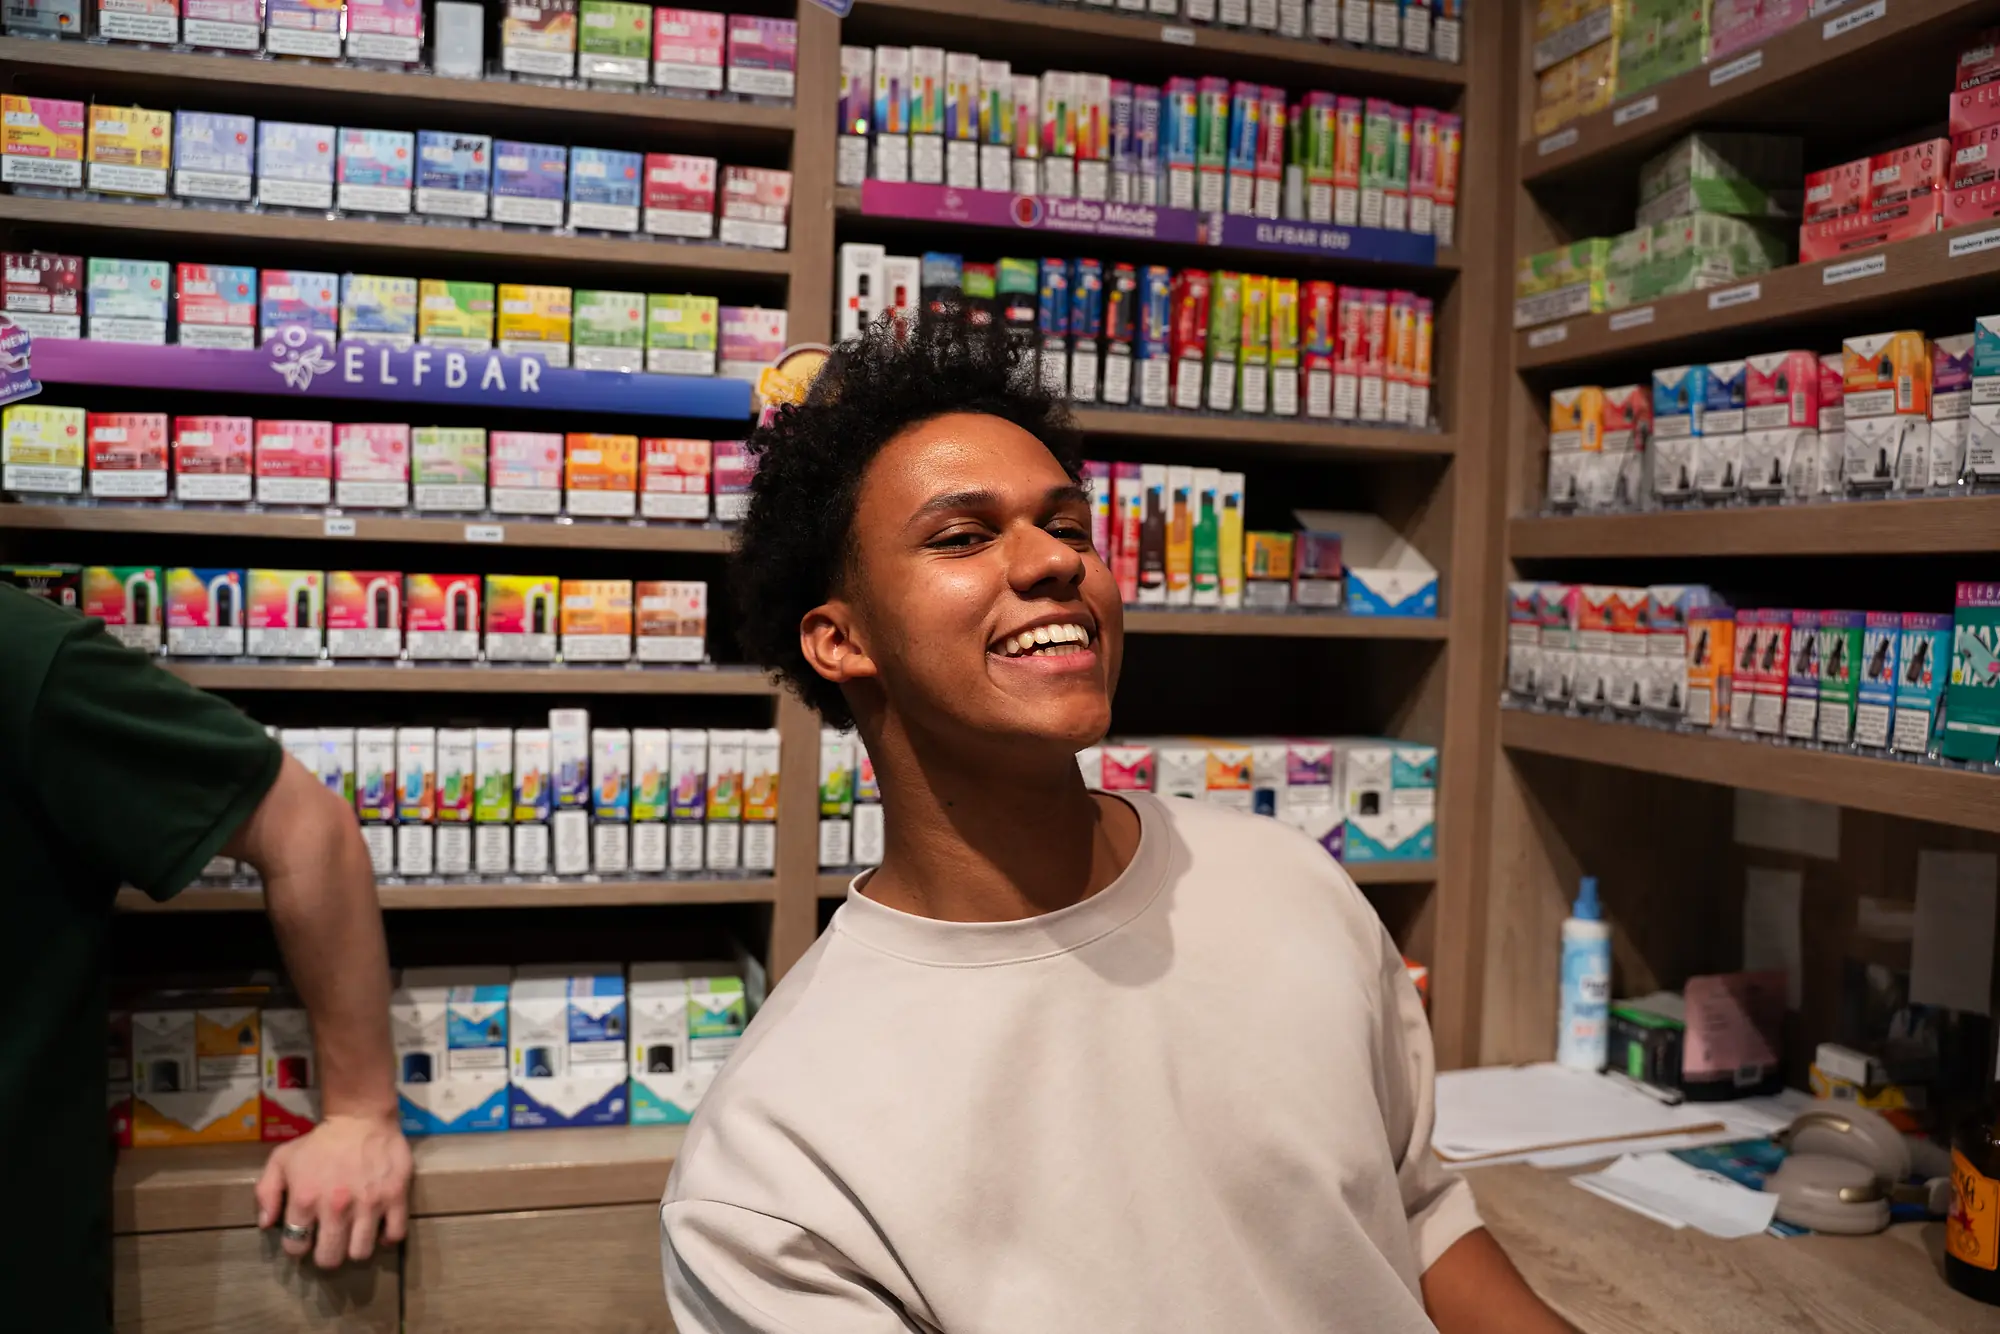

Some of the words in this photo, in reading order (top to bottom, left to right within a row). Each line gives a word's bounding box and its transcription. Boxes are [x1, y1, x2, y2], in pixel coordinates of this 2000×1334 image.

[1046, 198, 1100, 221] Turbo
[1104, 203, 1157, 225] Mode
[1256, 223, 1317, 247] ELFBAR
[344, 346, 541, 393] ELFBAR
